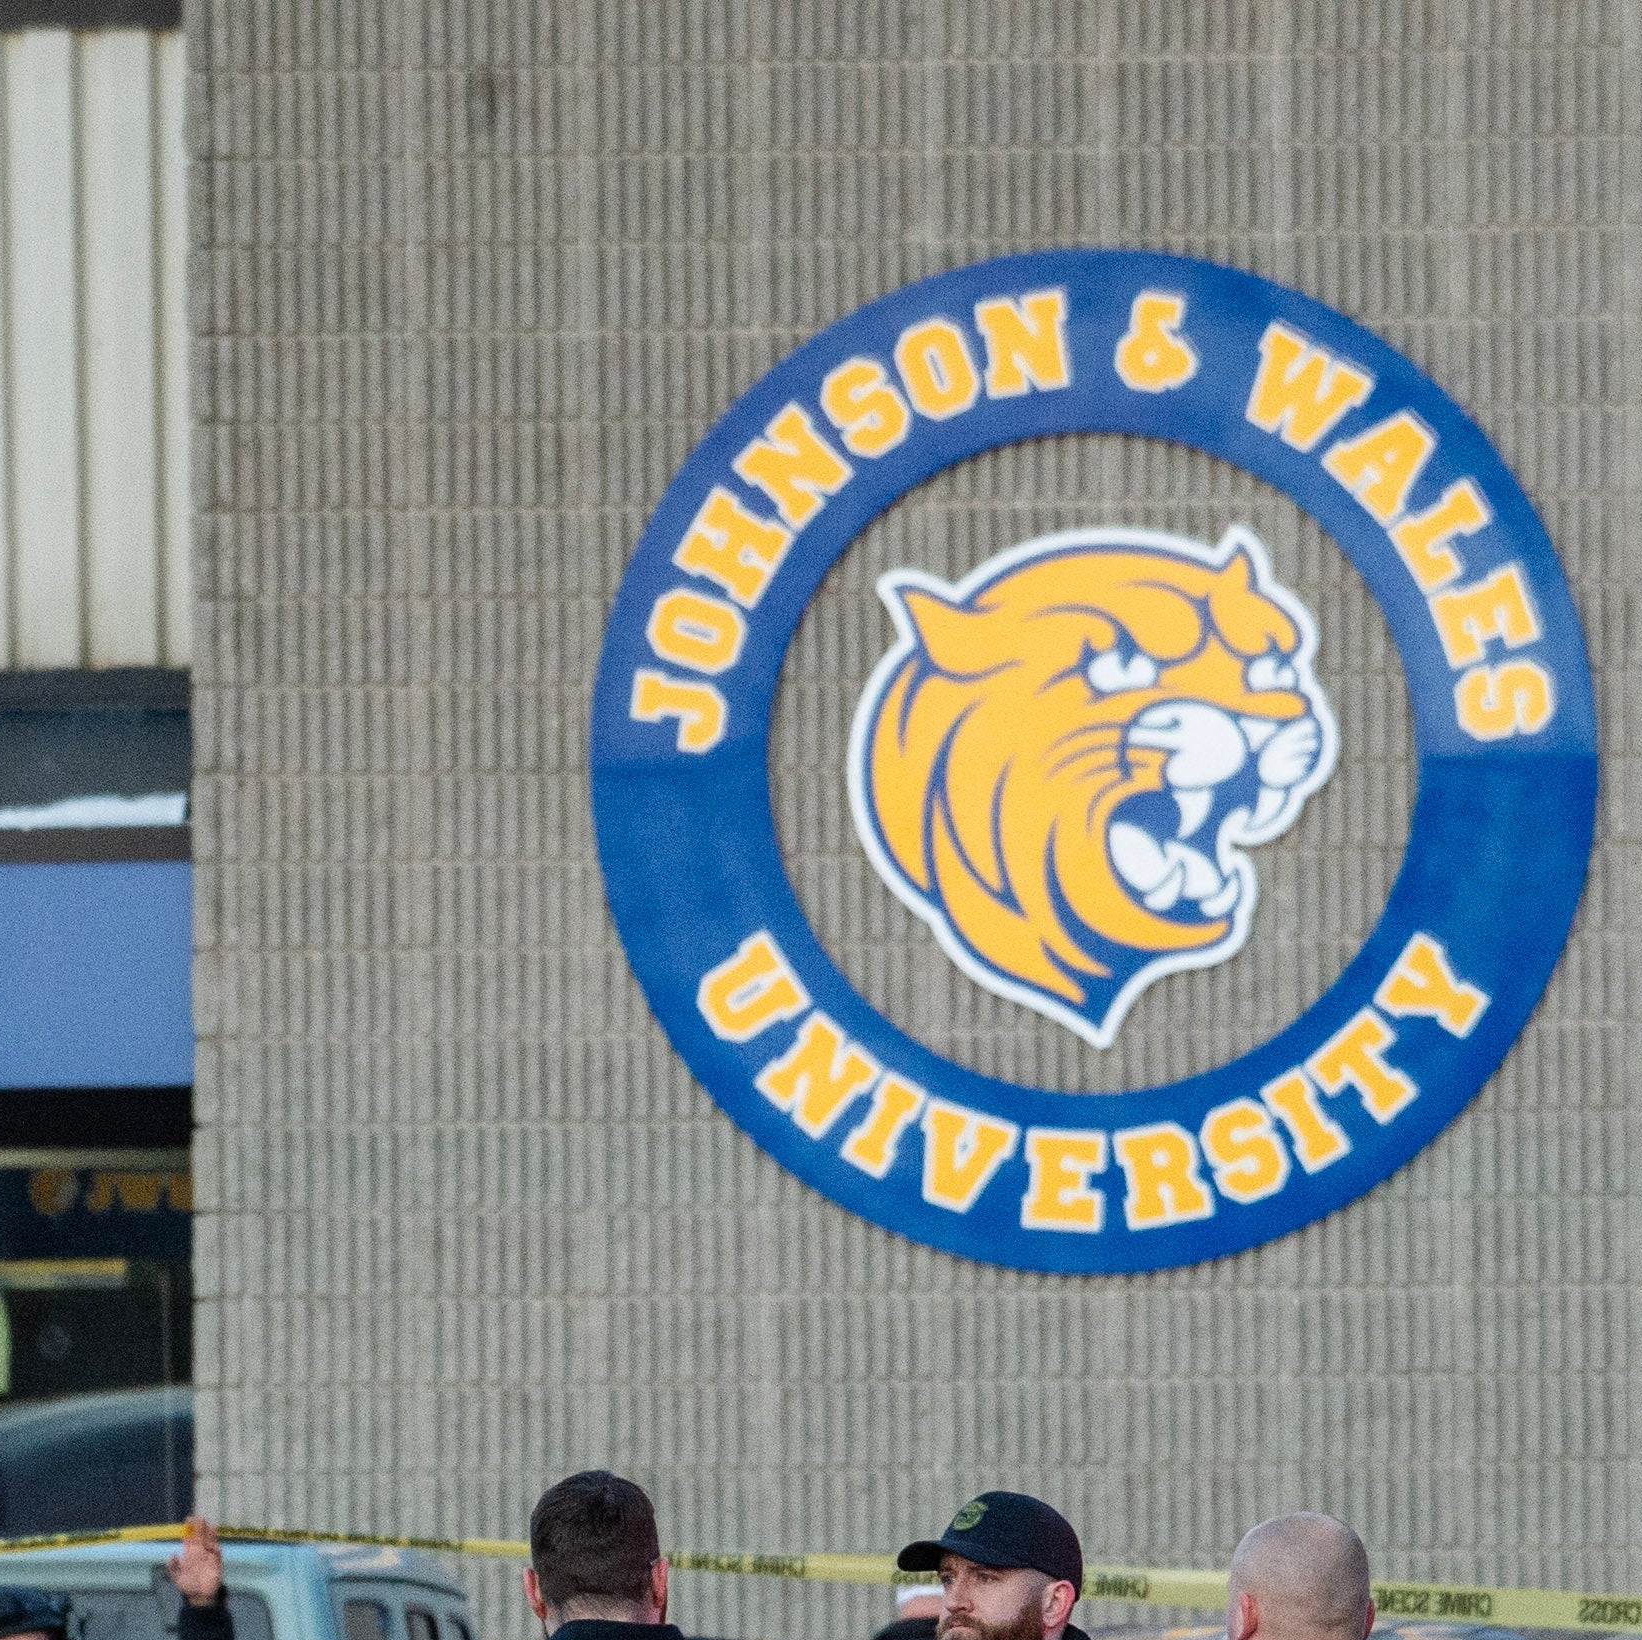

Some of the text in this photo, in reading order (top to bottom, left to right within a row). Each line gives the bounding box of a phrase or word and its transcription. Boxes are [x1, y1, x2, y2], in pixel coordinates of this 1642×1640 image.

[630, 288, 1554, 757] JOHNSON & WALES
[696, 929, 1491, 1231] UNIVERSITY
